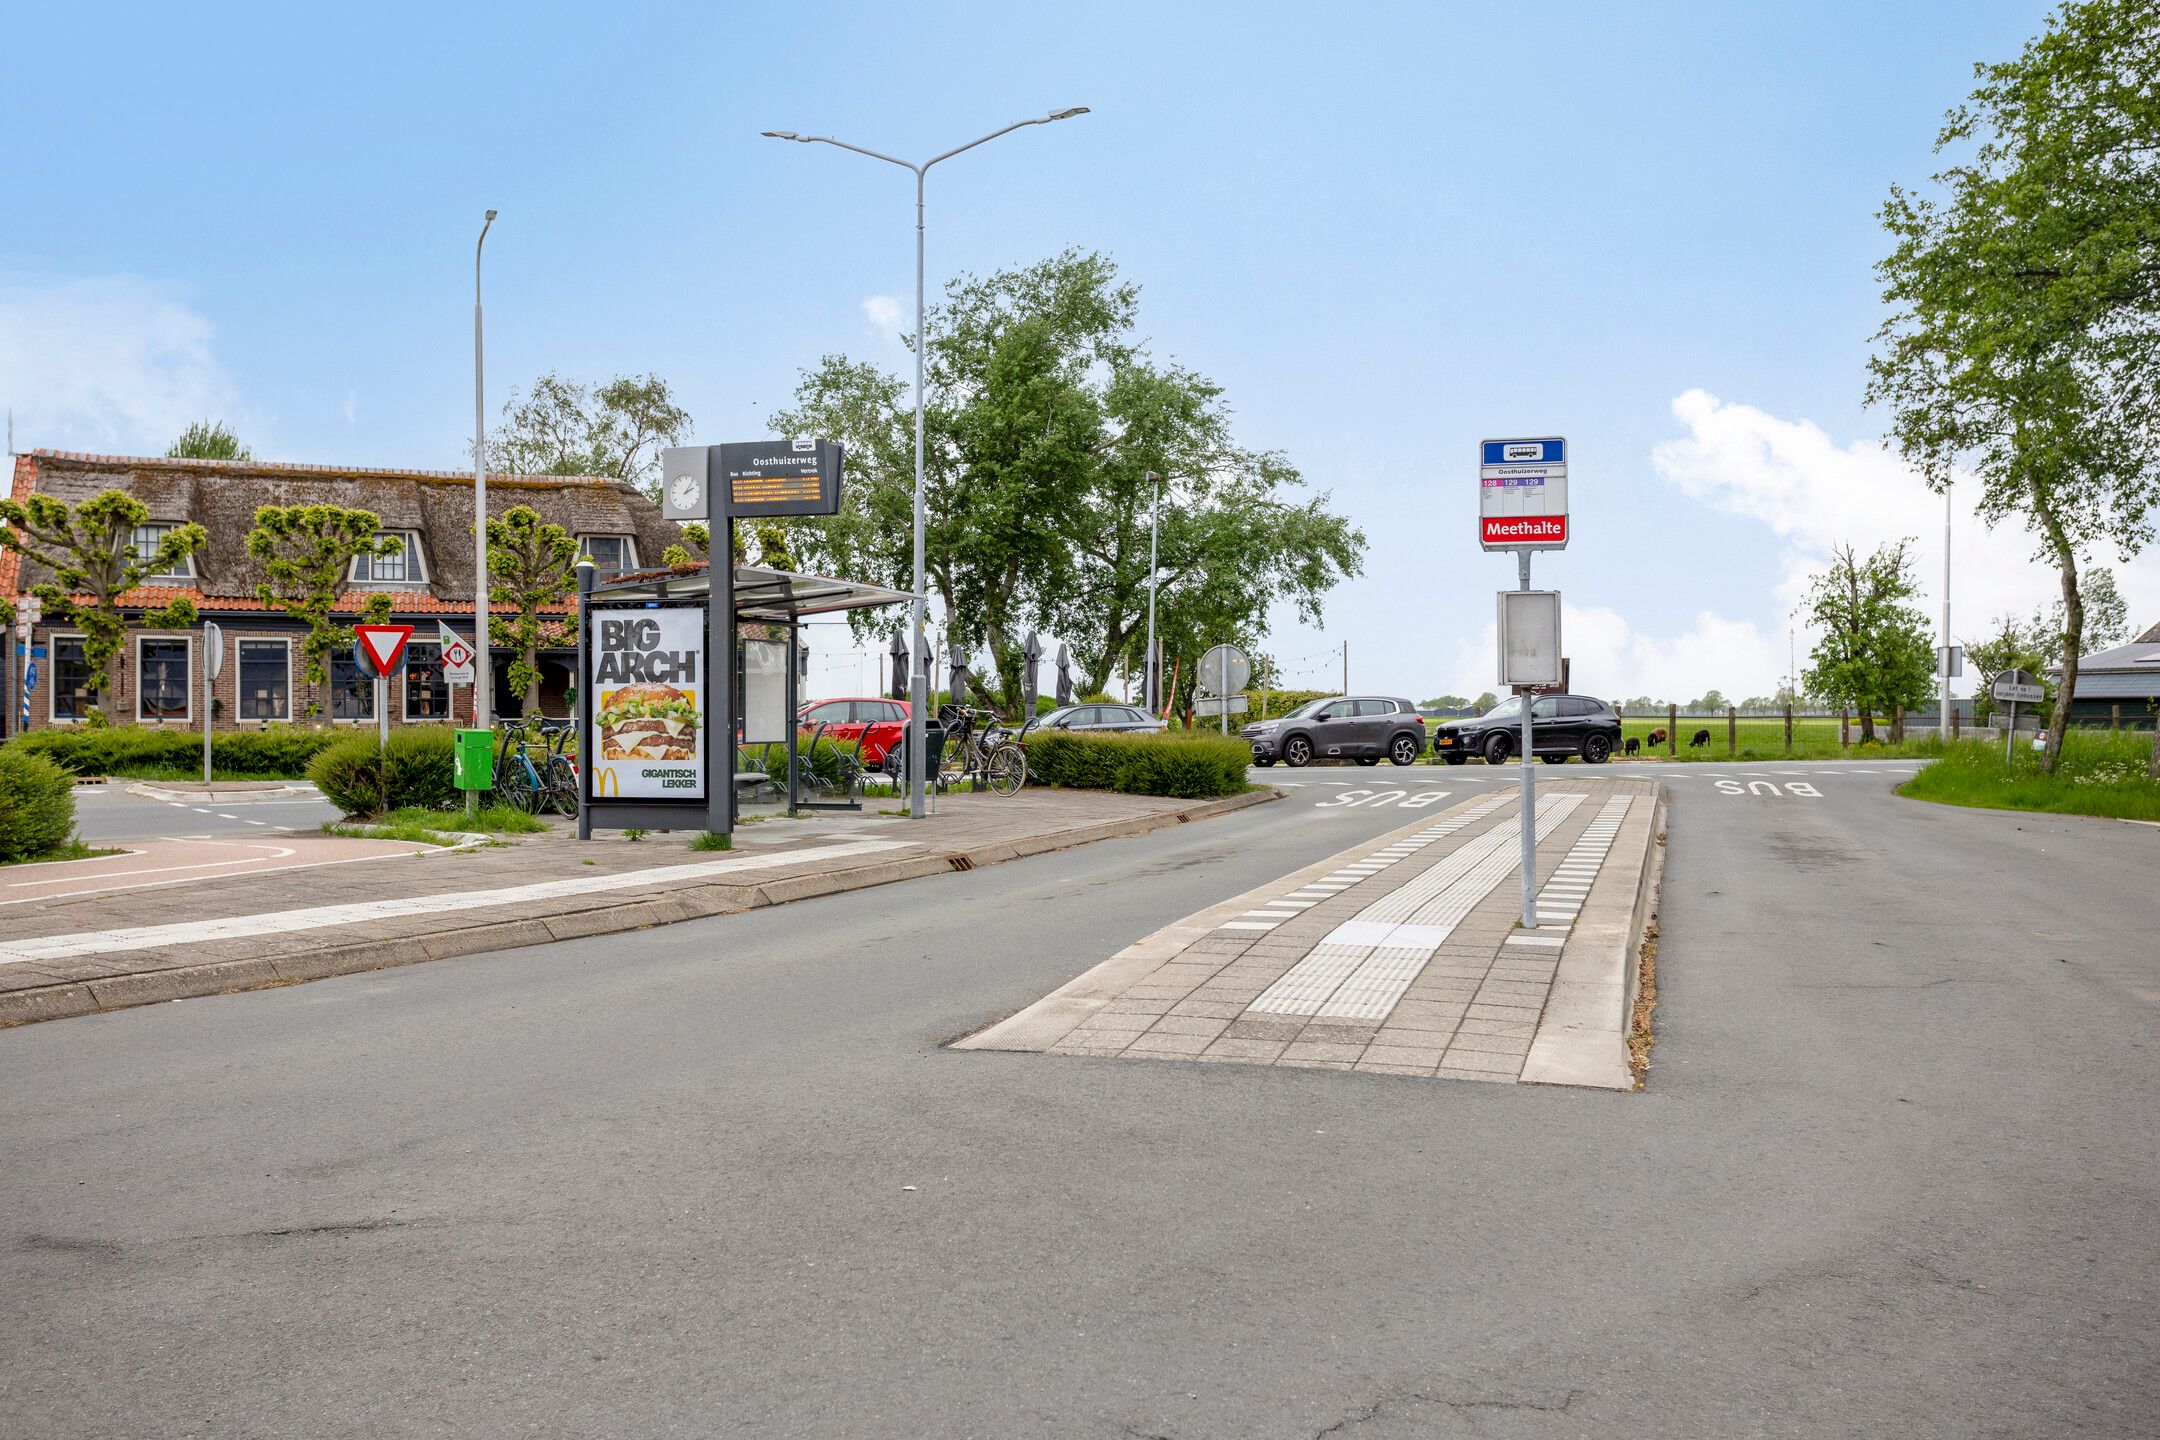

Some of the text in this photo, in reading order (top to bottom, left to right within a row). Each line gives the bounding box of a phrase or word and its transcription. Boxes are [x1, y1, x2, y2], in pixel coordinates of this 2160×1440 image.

[753, 456, 817, 466] Oosthuizerweg
[1525, 478, 1539, 486] 129
[1486, 521, 1561, 536] Meethalte
[601, 618, 661, 652] BIG
[595, 650, 696, 685] ARCH
[641, 769, 697, 779] GIGANTISCH
[662, 779, 697, 789] LEKKER
[1714, 780, 1825, 798] BUS
[1314, 789, 1452, 808] BUS
